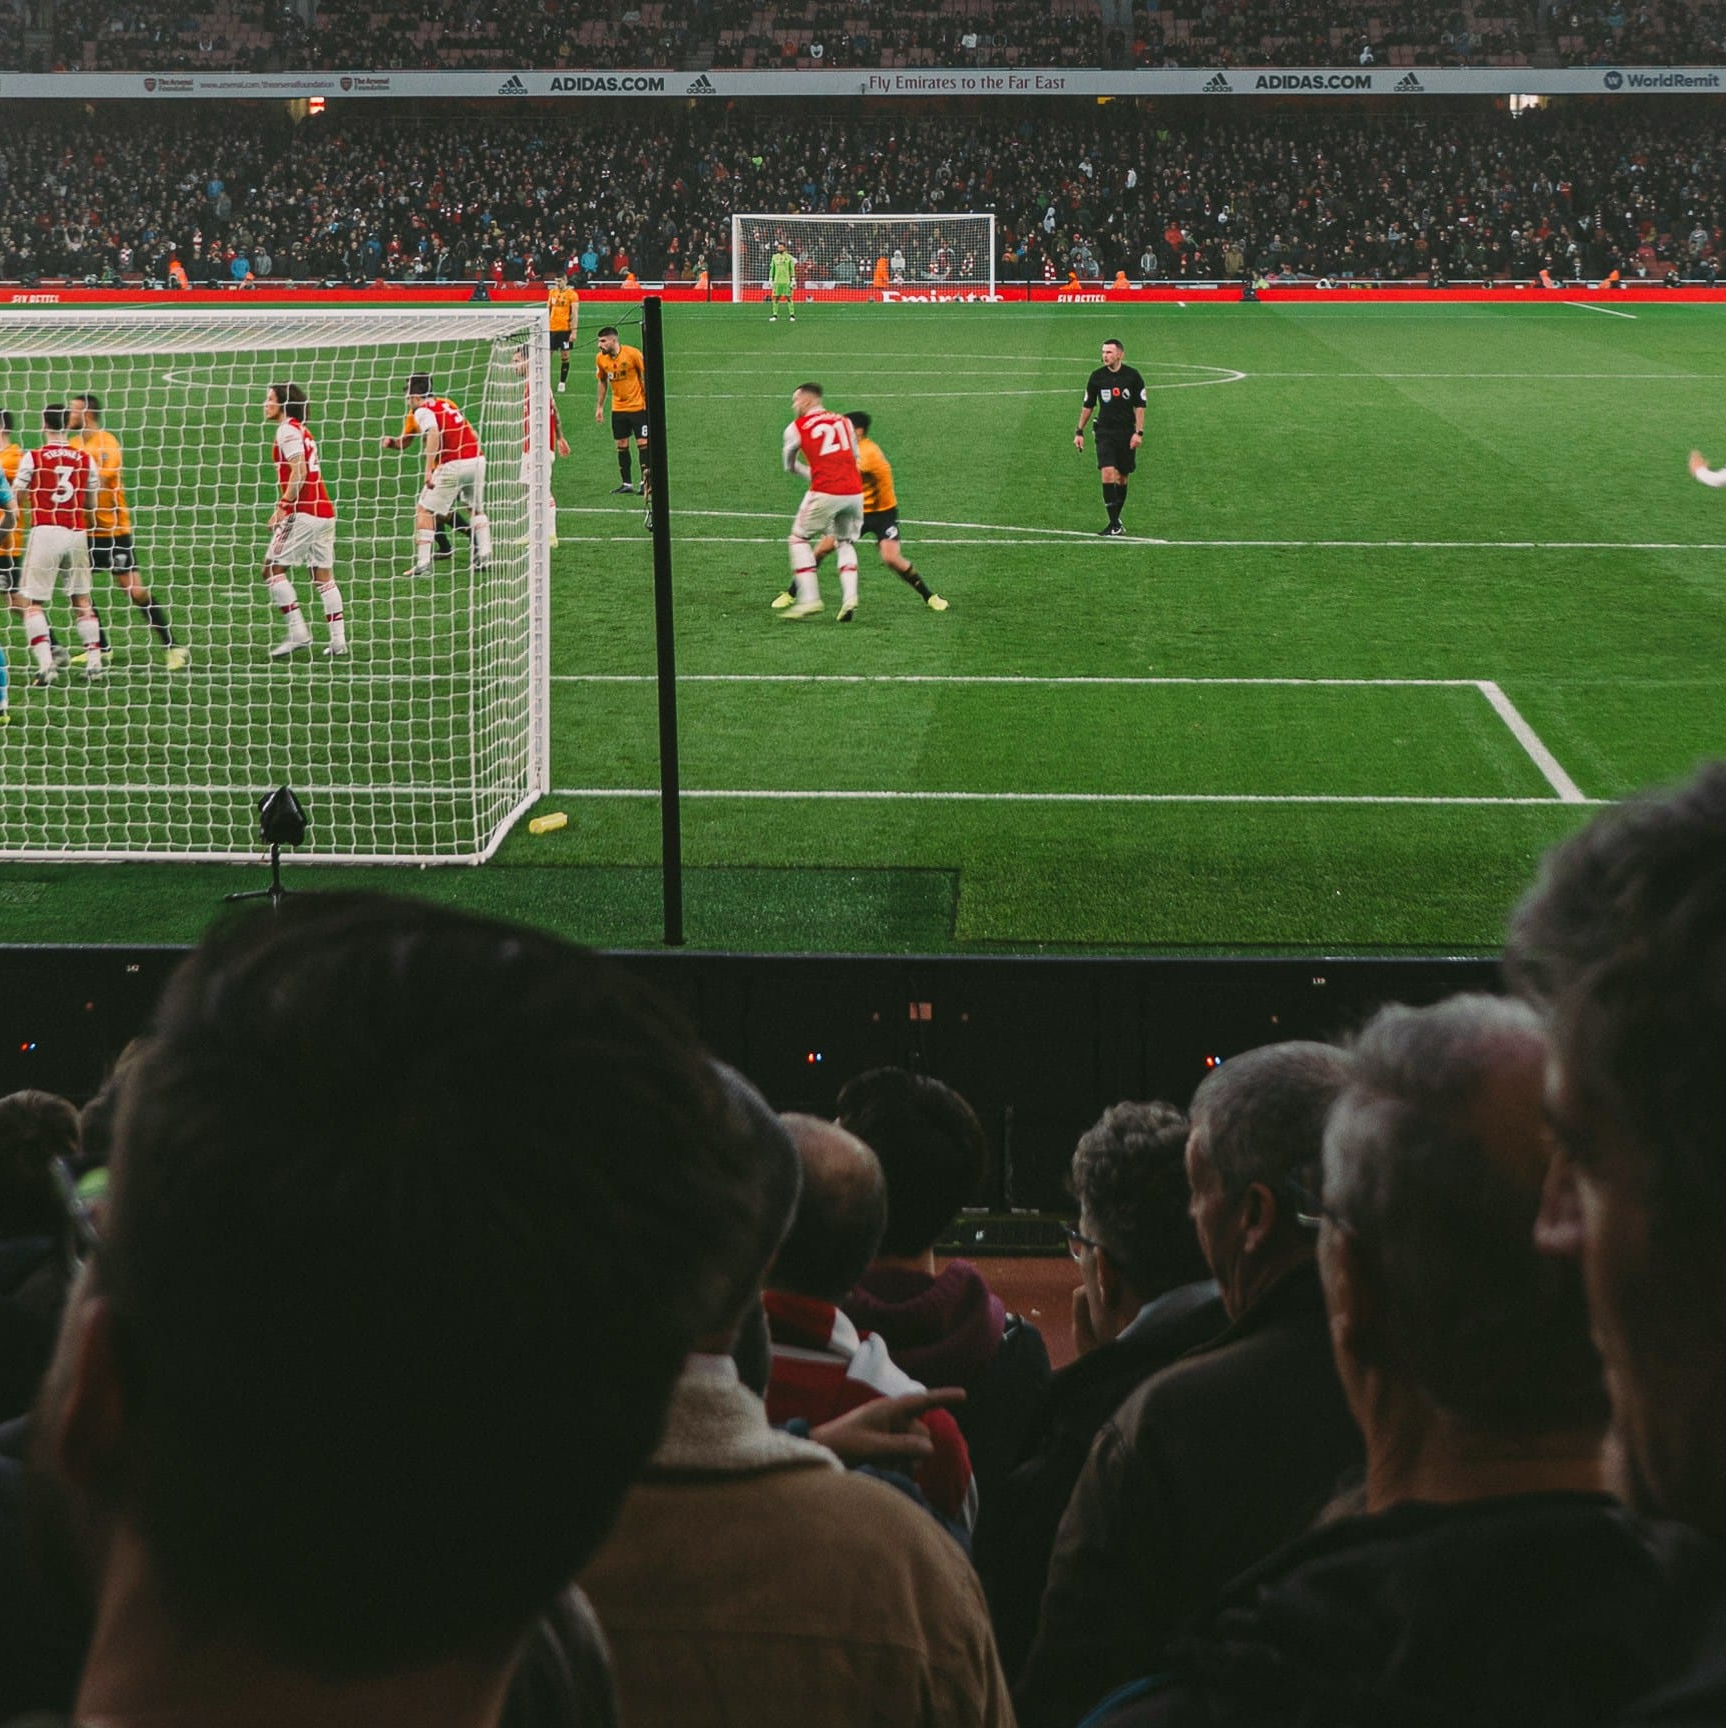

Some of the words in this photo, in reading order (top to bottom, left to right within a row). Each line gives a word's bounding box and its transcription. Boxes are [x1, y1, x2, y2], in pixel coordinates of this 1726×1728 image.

[550, 77, 665, 92] ADIDAS.COM
[869, 76, 891, 93] Fly
[896, 75, 957, 90] Emirates
[961, 78, 975, 90] to
[980, 75, 1003, 90] the
[1008, 75, 1031, 90] Far
[1036, 75, 1066, 90] East
[1255, 75, 1372, 90] ADIDAS.COM
[1626, 73, 1720, 89] WorldRemit
[498, 87, 528, 95] adidas
[686, 87, 716, 95] adidas
[1202, 85, 1233, 94] adidas
[1393, 85, 1425, 93] adidas
[642, 424, 649, 437] 8
[811, 420, 851, 457] 21
[43, 449, 84, 462] TIERNEY
[50, 465, 74, 504] 3
